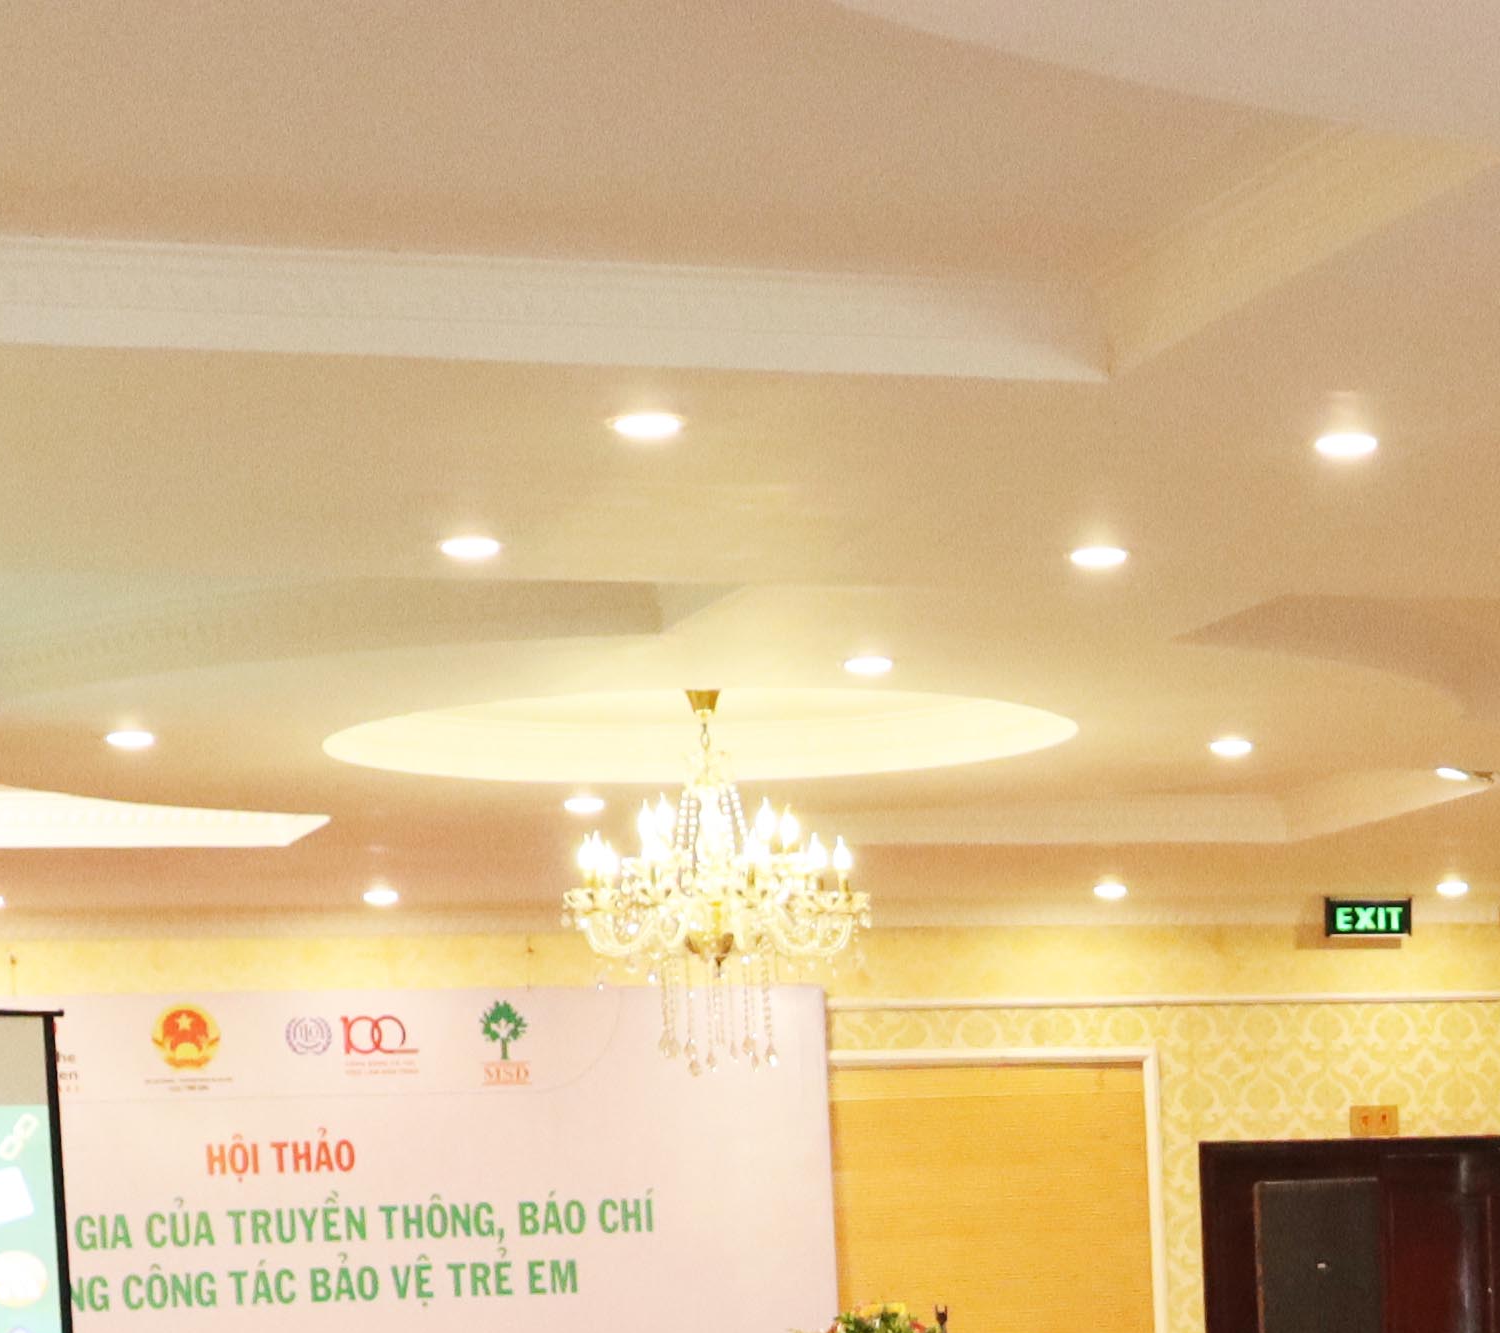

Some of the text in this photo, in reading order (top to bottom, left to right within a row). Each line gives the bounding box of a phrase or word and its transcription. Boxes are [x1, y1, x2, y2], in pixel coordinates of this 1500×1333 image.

[1335, 906, 1403, 931] EXIT
[483, 1064, 530, 1084] MSD
[206, 1127, 356, 1183] HỘI THẢO
[74, 1187, 655, 1250] GIA CỦA TRUYỀN THÔNG, BÁO CHÍ
[70, 1246, 579, 1312] NG CÔNG TÁC BẢO VỆ TRẺ EM
